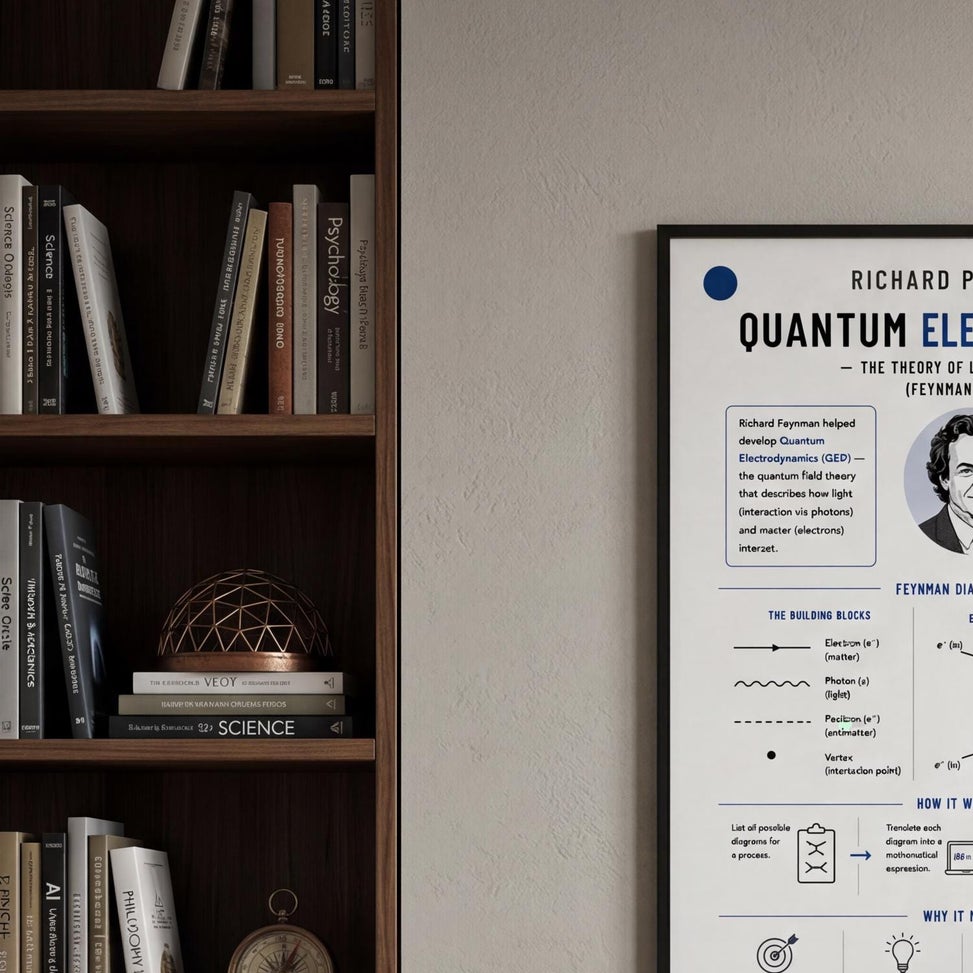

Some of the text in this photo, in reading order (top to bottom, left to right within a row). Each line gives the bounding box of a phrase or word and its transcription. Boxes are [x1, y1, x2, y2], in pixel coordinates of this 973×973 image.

[852, 270, 949, 290] RICHARD
[740, 312, 905, 352] QUANTUM
[861, 361, 885, 374] THE
[891, 361, 941, 374] THEORY
[948, 361, 963, 374] OF
[906, 382, 971, 398] (FEYNMAN
[739, 418, 774, 427] Richard
[823, 418, 855, 430] helped
[739, 436, 824, 448] develop Quantum
[739, 453, 818, 465] Electrodynamics
[739, 471, 754, 480] the
[757, 473, 799, 482] quantum
[739, 489, 853, 500] that describes how light
[739, 507, 792, 517] (interaction
[811, 507, 853, 519] photons)
[739, 525, 756, 534] and
[794, 525, 844, 536] (electrons)
[896, 583, 949, 595] FEYNMAN
[768, 611, 870, 620] THE BUILDING BLOCKS
[825, 652, 859, 662] (matter)
[825, 676, 856, 685] Photon
[218, 719, 296, 736] SCIENCE
[825, 753, 853, 761] Vertex
[917, 798, 941, 809] HOW
[947, 798, 957, 809] IT
[770, 837, 780, 845] for
[920, 837, 935, 845] into
[45, 881, 62, 901] AI
[923, 910, 948, 922] WHY
[954, 910, 964, 922] IT
